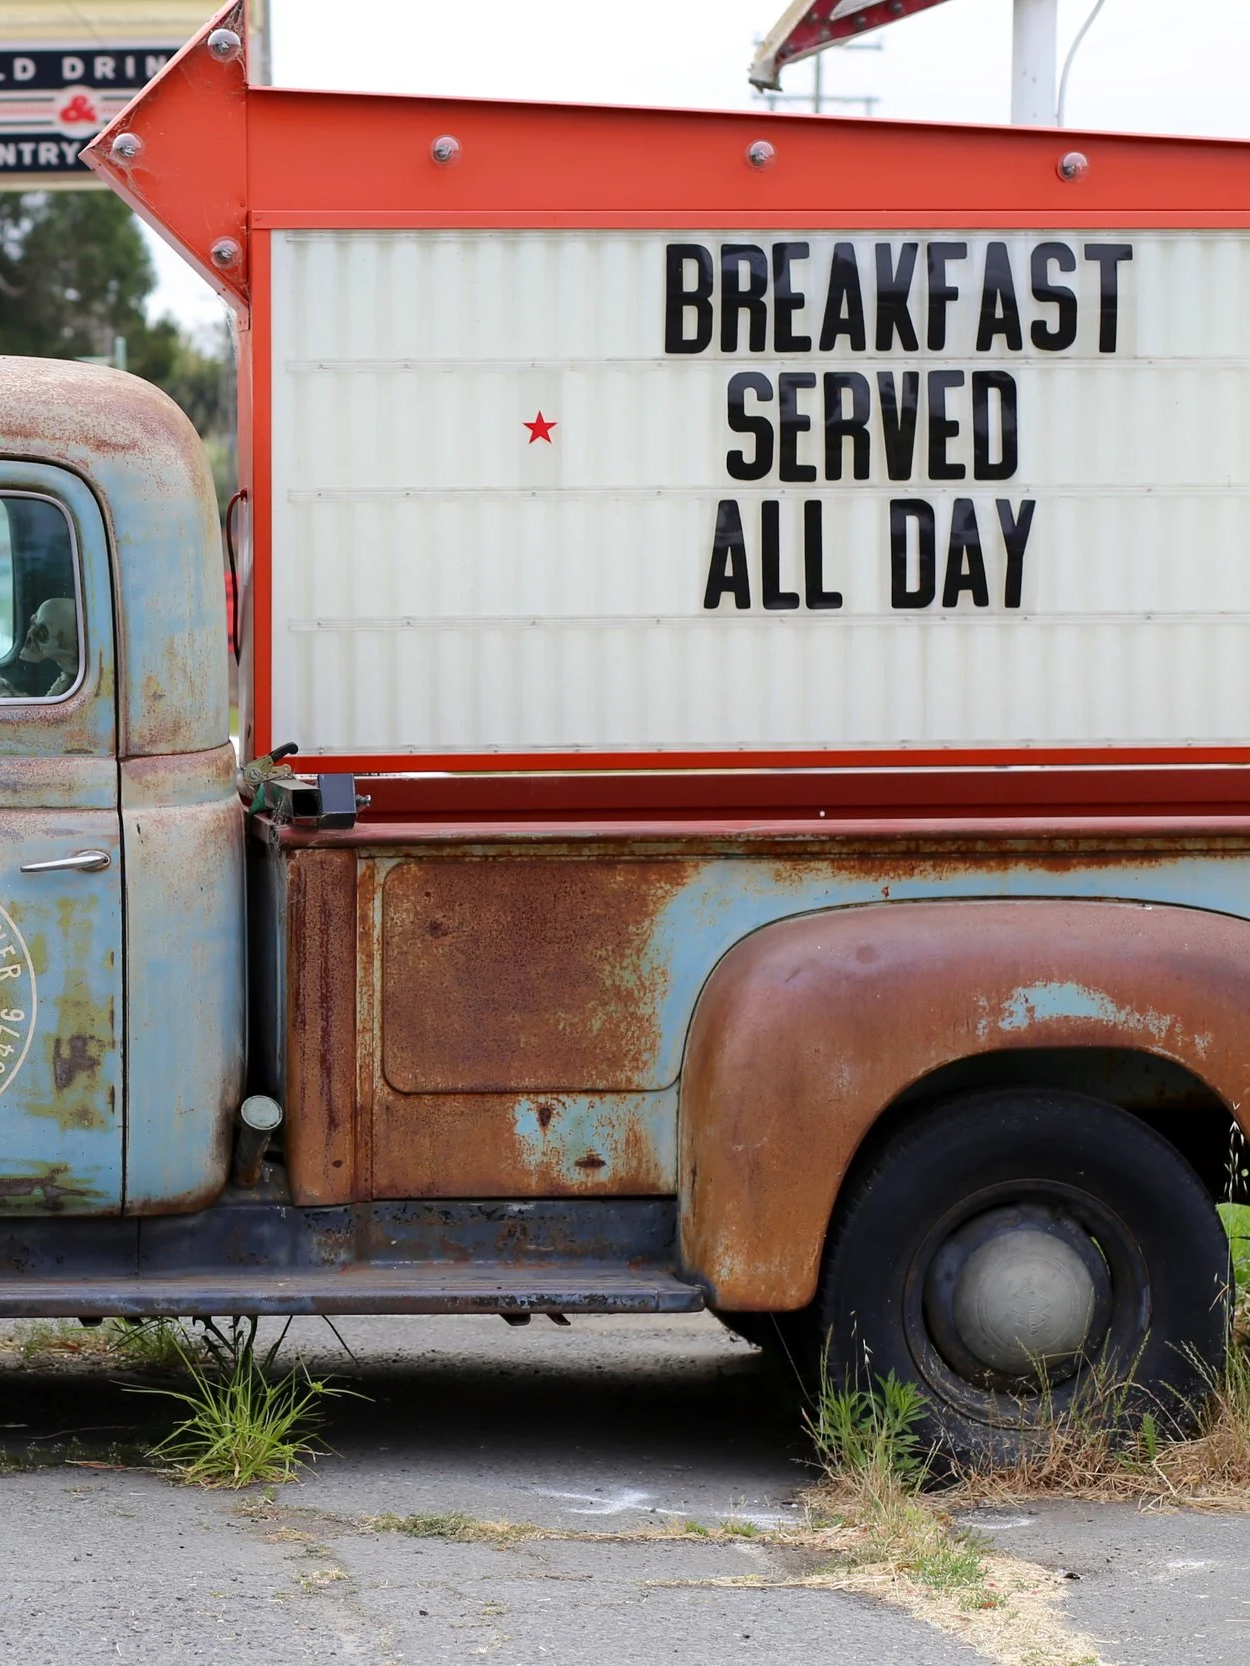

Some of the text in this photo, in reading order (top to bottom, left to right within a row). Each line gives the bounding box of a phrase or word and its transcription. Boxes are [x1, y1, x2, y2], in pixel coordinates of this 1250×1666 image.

[59, 95, 97, 123] &
[664, 241, 1134, 354] BREAKFAST
[726, 369, 1018, 483] SERVED
[703, 497, 1037, 610] ALL DAY
